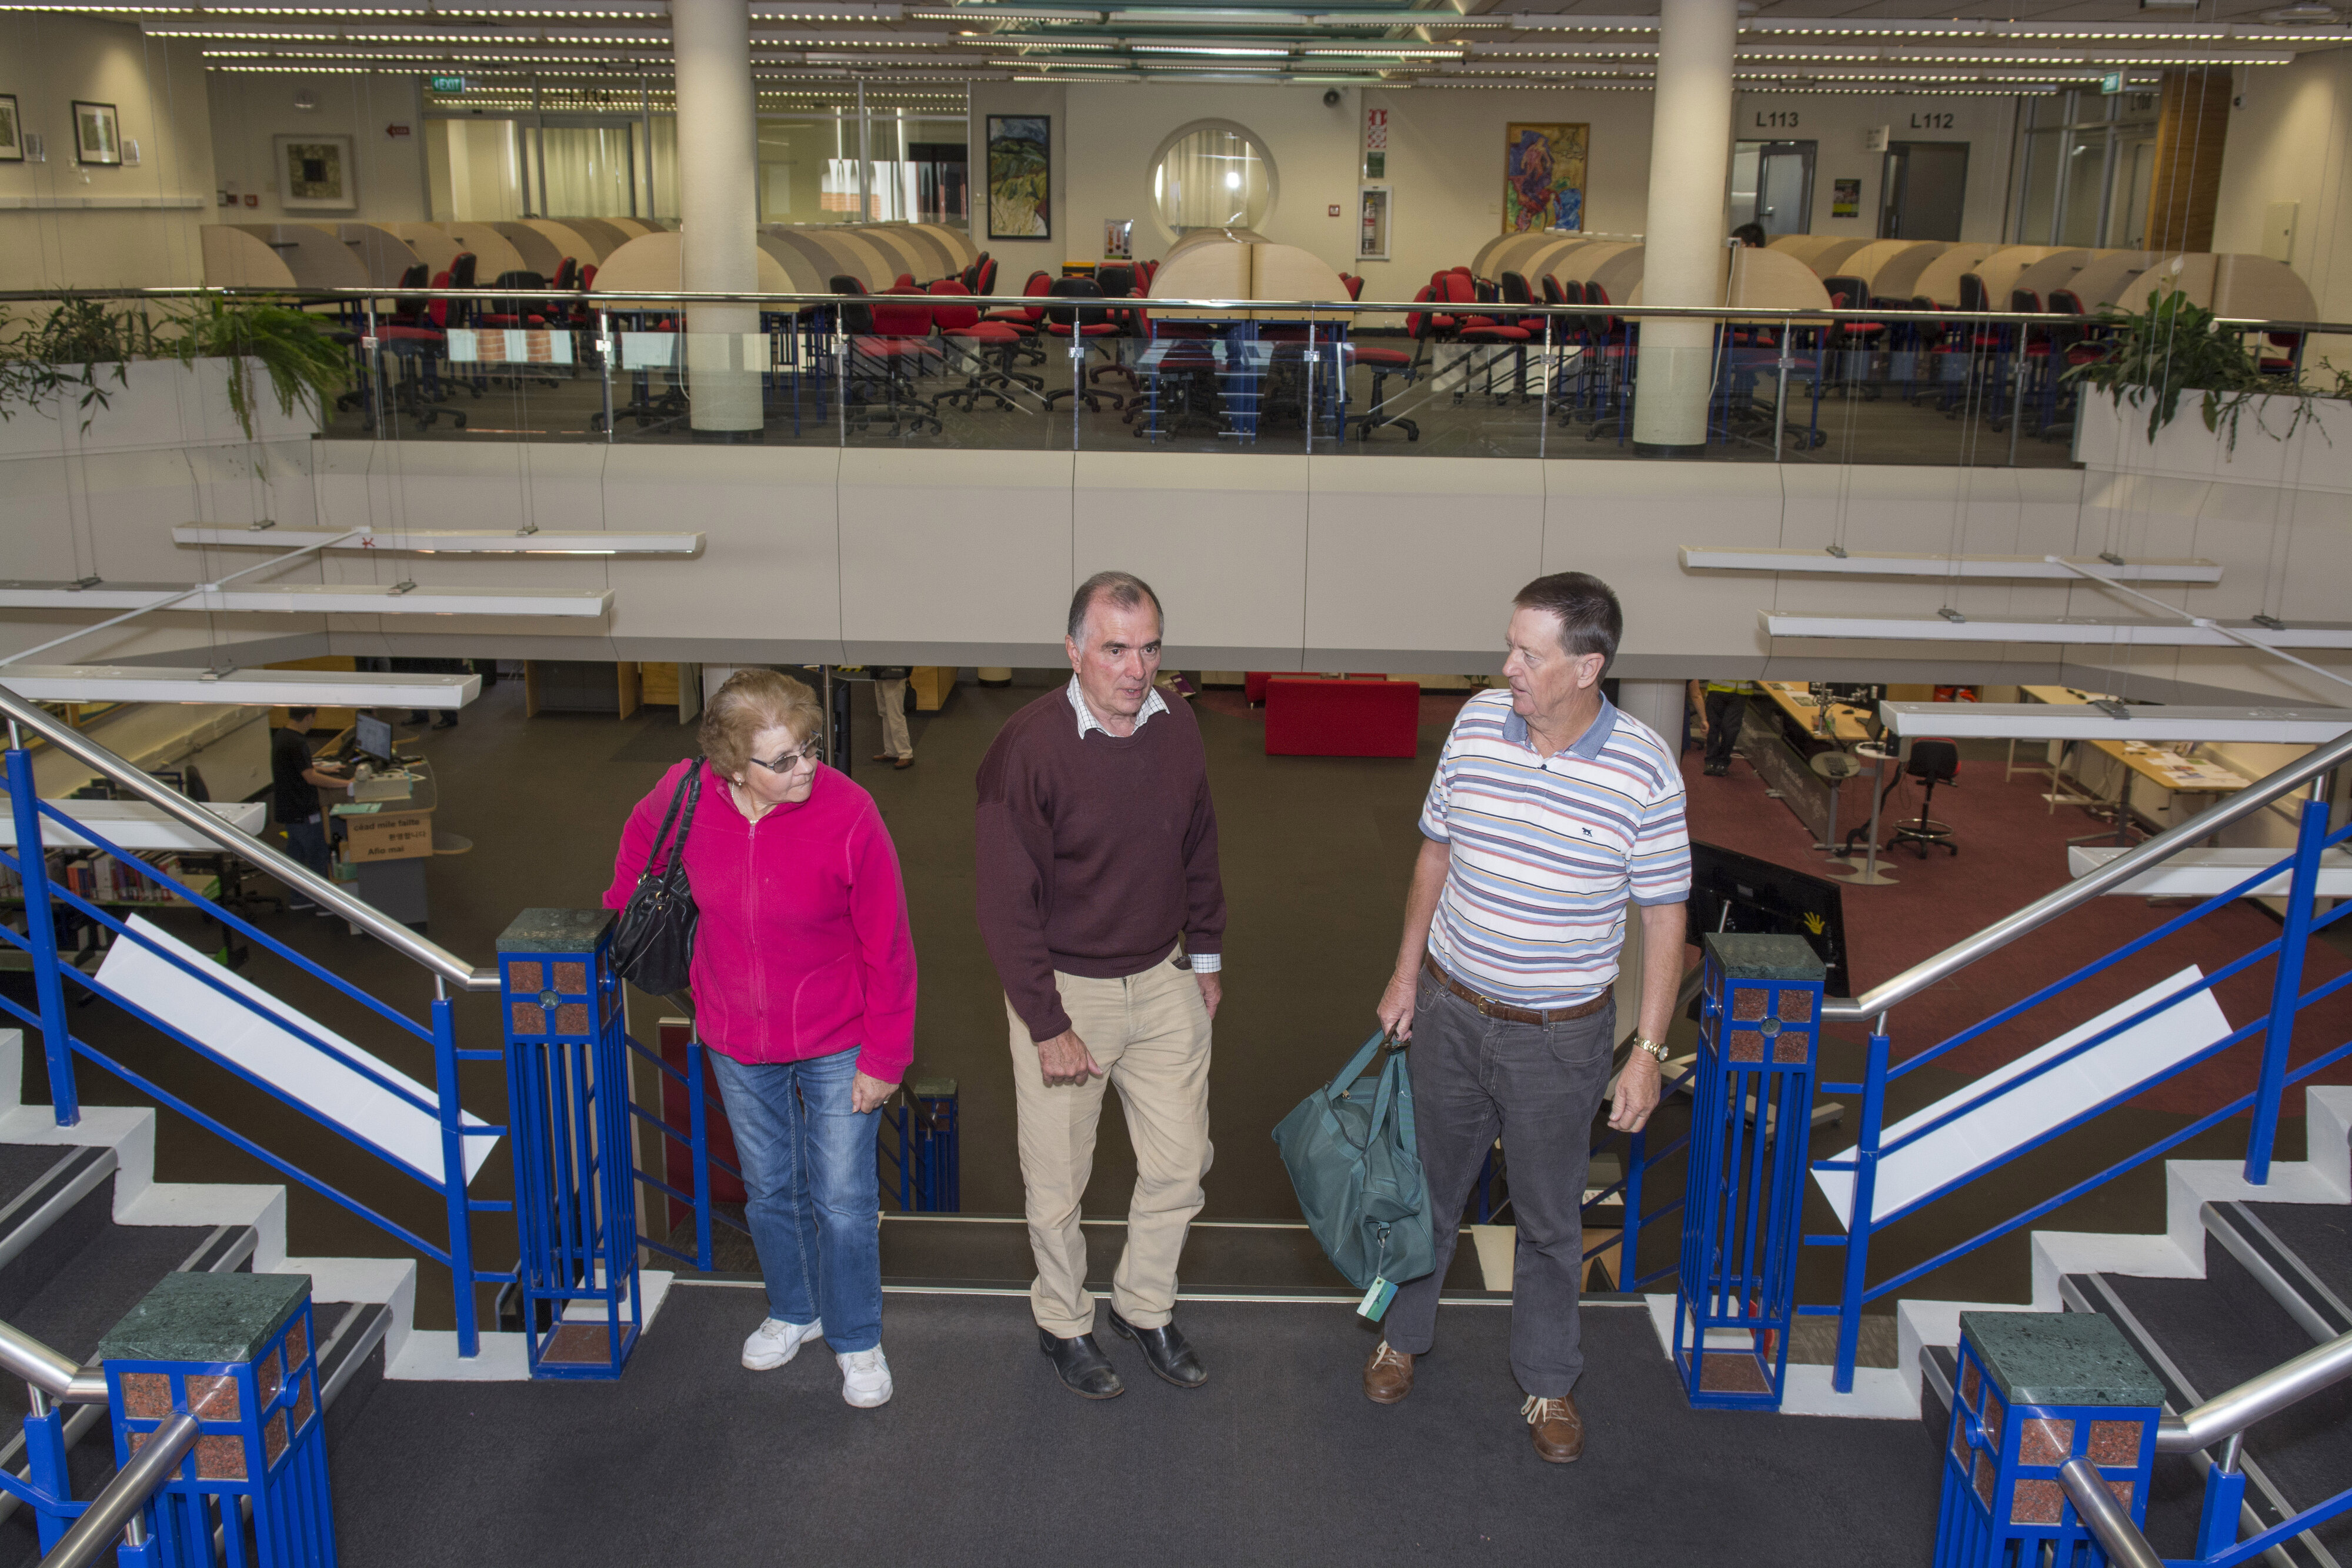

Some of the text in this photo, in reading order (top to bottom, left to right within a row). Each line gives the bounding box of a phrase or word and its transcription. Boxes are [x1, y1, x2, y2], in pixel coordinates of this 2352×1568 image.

[439, 78, 460, 90] EXIT
[1756, 111, 1799, 127] L113
[1911, 112, 1954, 128] L112
